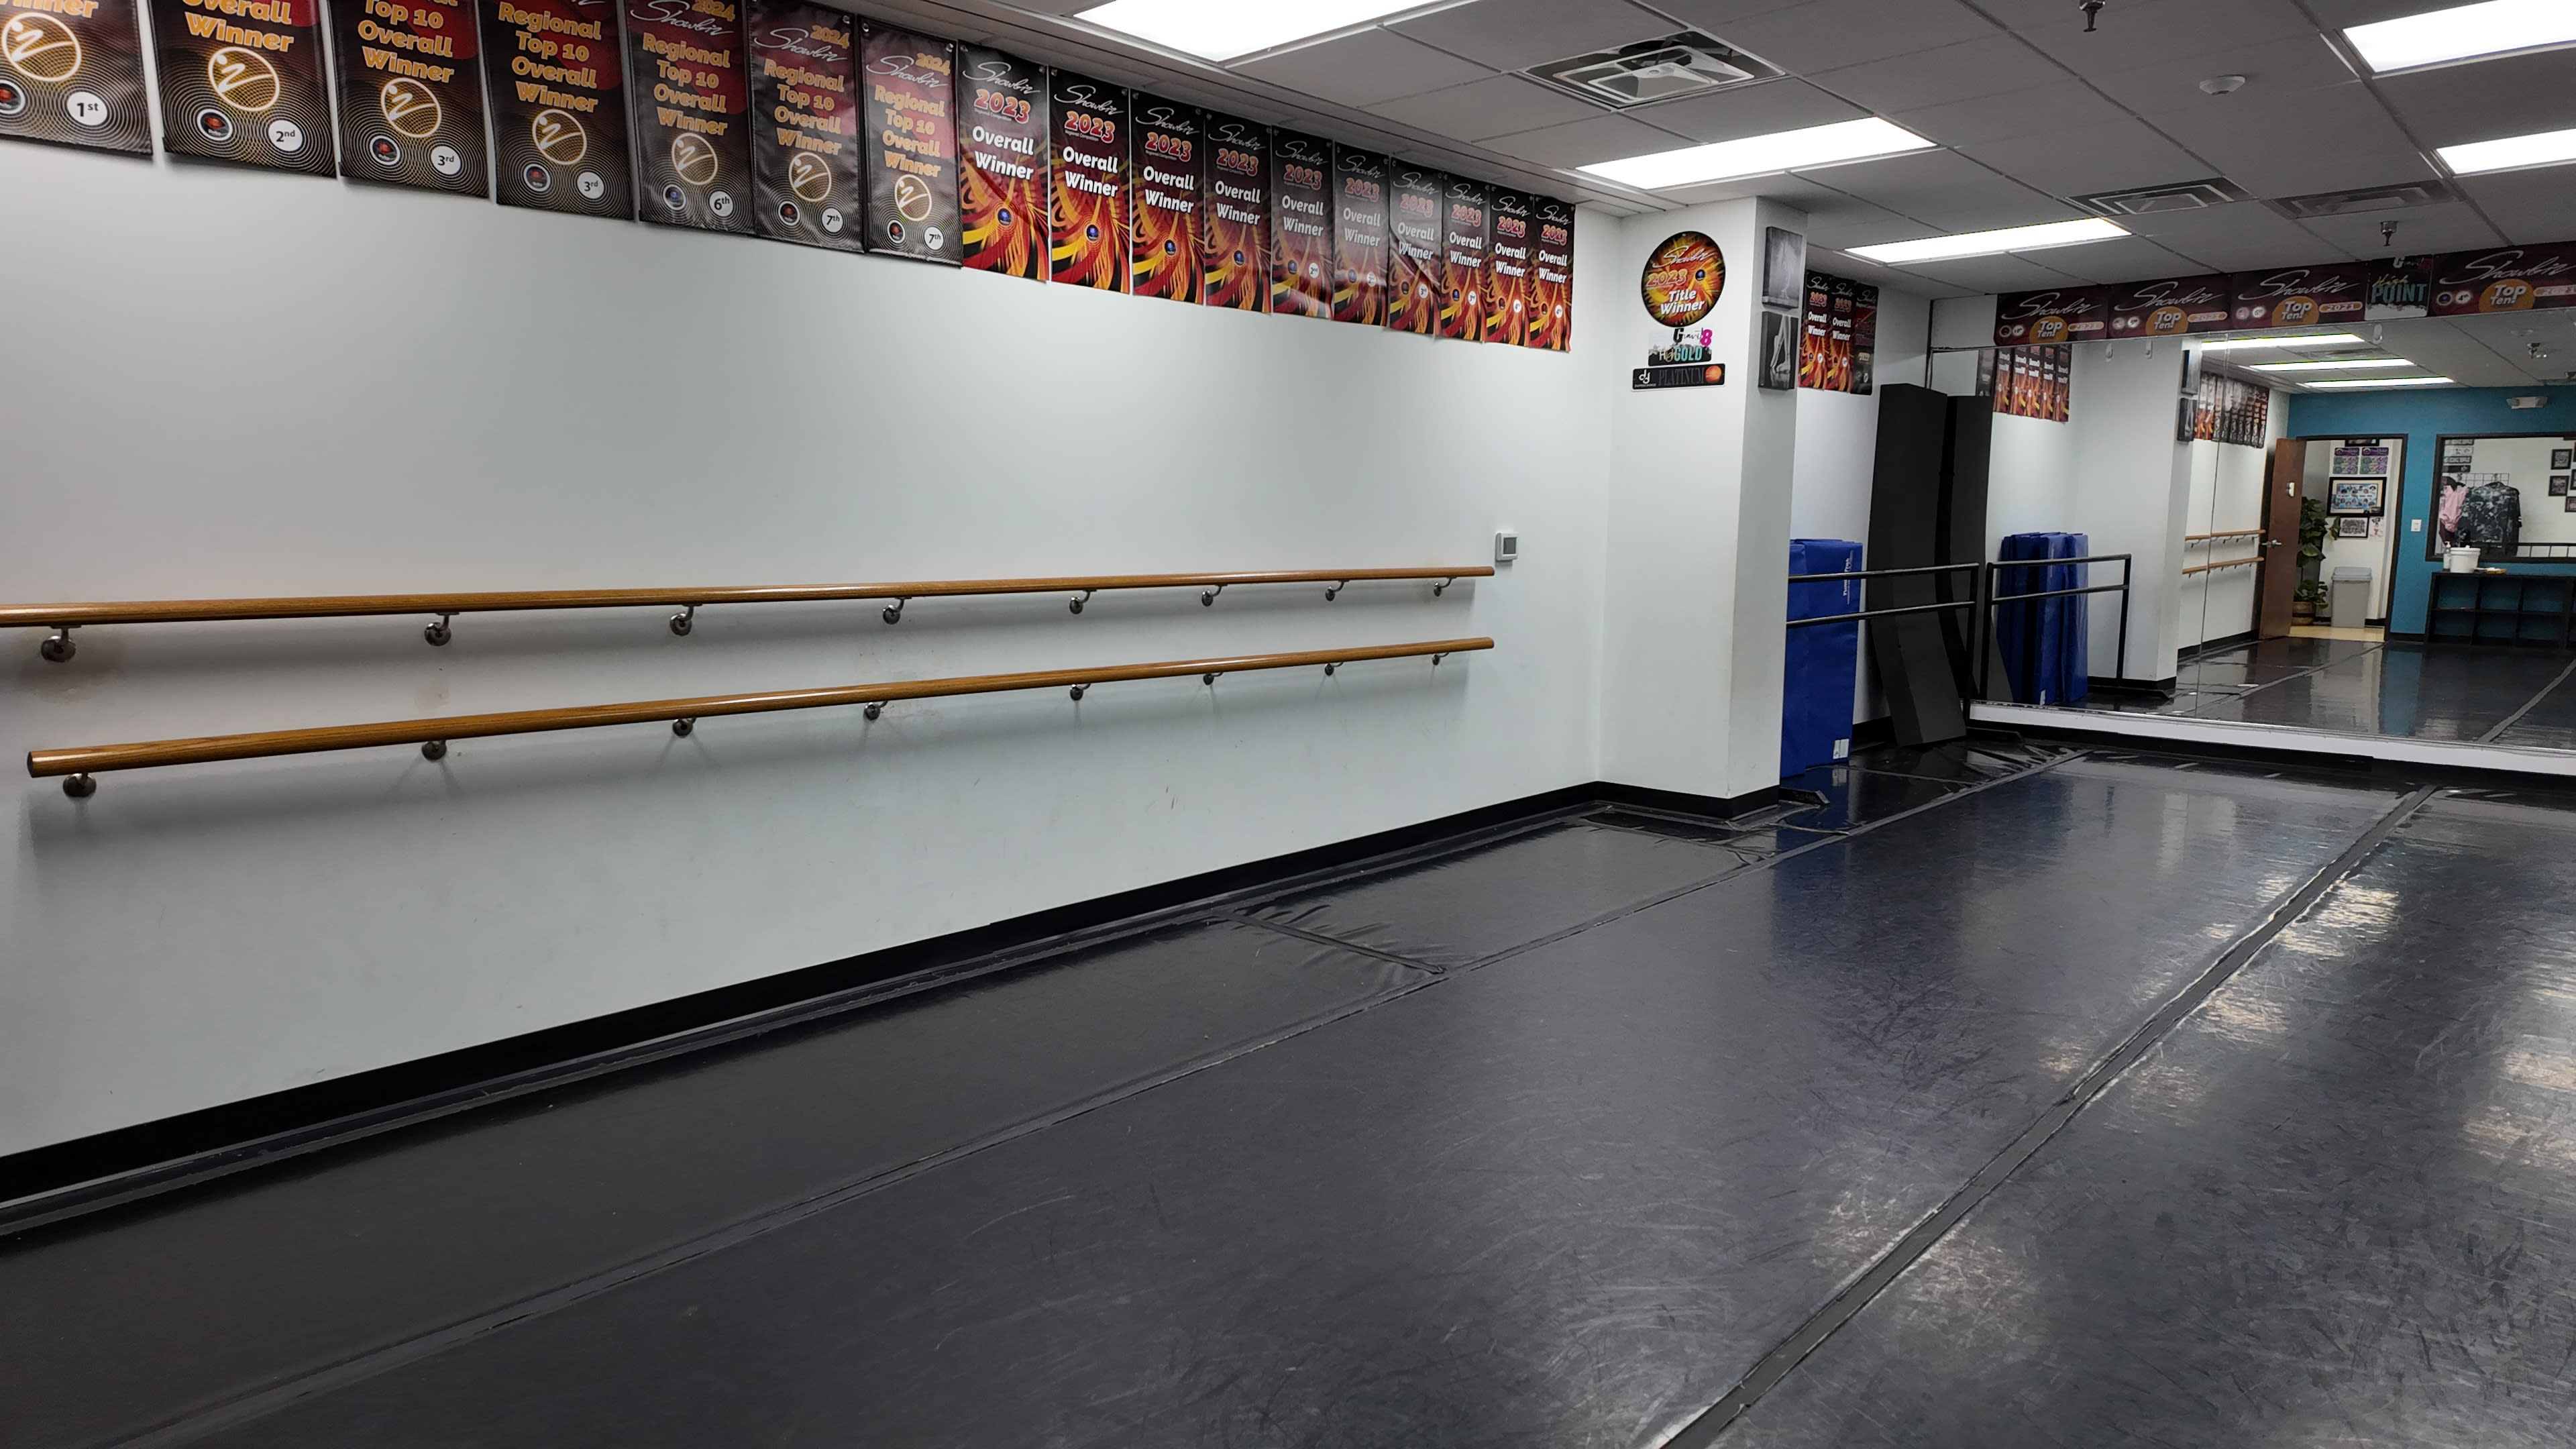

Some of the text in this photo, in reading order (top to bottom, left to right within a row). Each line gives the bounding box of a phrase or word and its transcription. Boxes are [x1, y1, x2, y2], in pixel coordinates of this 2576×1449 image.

[0, 0, 99, 18] ner
[182, 0, 291, 25] verall
[365, 0, 443, 29] Top 10
[692, 0, 736, 22] 2024
[184, 11, 294, 52] Winner
[498, 1, 602, 40] Regional
[358, 19, 453, 58] Overall
[516, 30, 590, 62] Top 10
[810, 25, 850, 50] 2024
[642, 32, 731, 68] Regional
[362, 46, 455, 83] Winner
[511, 56, 597, 89] Overall
[657, 59, 719, 89] Top 10
[915, 52, 951, 76] 2024
[763, 58, 845, 93] Regional
[515, 80, 598, 113] Winner
[653, 83, 727, 113] Overall
[777, 83, 835, 111] Top 10
[874, 85, 945, 117] Regional
[973, 89, 1030, 124] 2023
[76, 102, 99, 117] 1st
[774, 105, 841, 134] Overall
[657, 106, 728, 136] Winner
[885, 108, 935, 135] Top 10
[1064, 111, 1115, 144] 2023
[276, 129, 295, 142] 2nd
[776, 127, 842, 156] Winner
[882, 129, 941, 158] Overall
[973, 125, 1034, 156] Overall
[1145, 131, 1192, 162] 2023
[437, 155, 455, 166] 3rd
[884, 150, 941, 178] Winner
[975, 150, 1034, 180] Winner
[1063, 146, 1118, 174] Overall
[1216, 148, 1258, 177] 2023
[584, 180, 598, 192] 3rd
[1065, 170, 1118, 197] Winner
[1143, 166, 1194, 191] Overall
[1283, 164, 1322, 191] 2023
[1145, 189, 1194, 213] Winner
[1215, 180, 1261, 204] Overall
[1344, 177, 1380, 203] 2023
[714, 197, 730, 211] 6th
[1216, 203, 1260, 225] Winner
[1282, 195, 1324, 216] Overall
[1400, 193, 1434, 218] 2023
[1451, 203, 1482, 227] 2023
[826, 215, 840, 225] 7th
[1283, 216, 1324, 237] Winner
[1343, 207, 1381, 227] Overall
[1497, 215, 1526, 238] 2023
[928, 233, 941, 244] 7th
[1344, 227, 1381, 247] Winner
[1397, 222, 1434, 241] Overall
[1449, 231, 1482, 250] Overall
[1541, 224, 1567, 246] 2023
[1398, 241, 1434, 260] Winner
[1450, 250, 1481, 268] Winner
[1495, 242, 1526, 260] Overall
[1538, 250, 1568, 267] Overall
[1495, 260, 1525, 278] Winner
[1539, 267, 1567, 284] Winner
[1646, 268, 1688, 287] 2023
[1668, 288, 1697, 302] Title
[2371, 283, 2426, 303] POINT
[2490, 296, 2515, 305] Ten!
[2494, 284, 2527, 300] Top
[1660, 300, 1705, 315] Winner
[1808, 311, 1827, 323] Overall
[2157, 311, 2182, 323] Top
[2282, 312, 2303, 320] Ten!
[2285, 301, 2312, 315] Top
[2326, 303, 2355, 311] 2021
[1808, 325, 1826, 336] Winner
[1833, 317, 1851, 327] Overall
[2037, 329, 2055, 337] Ten!
[2040, 320, 2063, 333] Top
[2154, 321, 2174, 329] Ten!
[1833, 330, 1851, 341] Winner
[1674, 345, 1703, 362] GOLD
